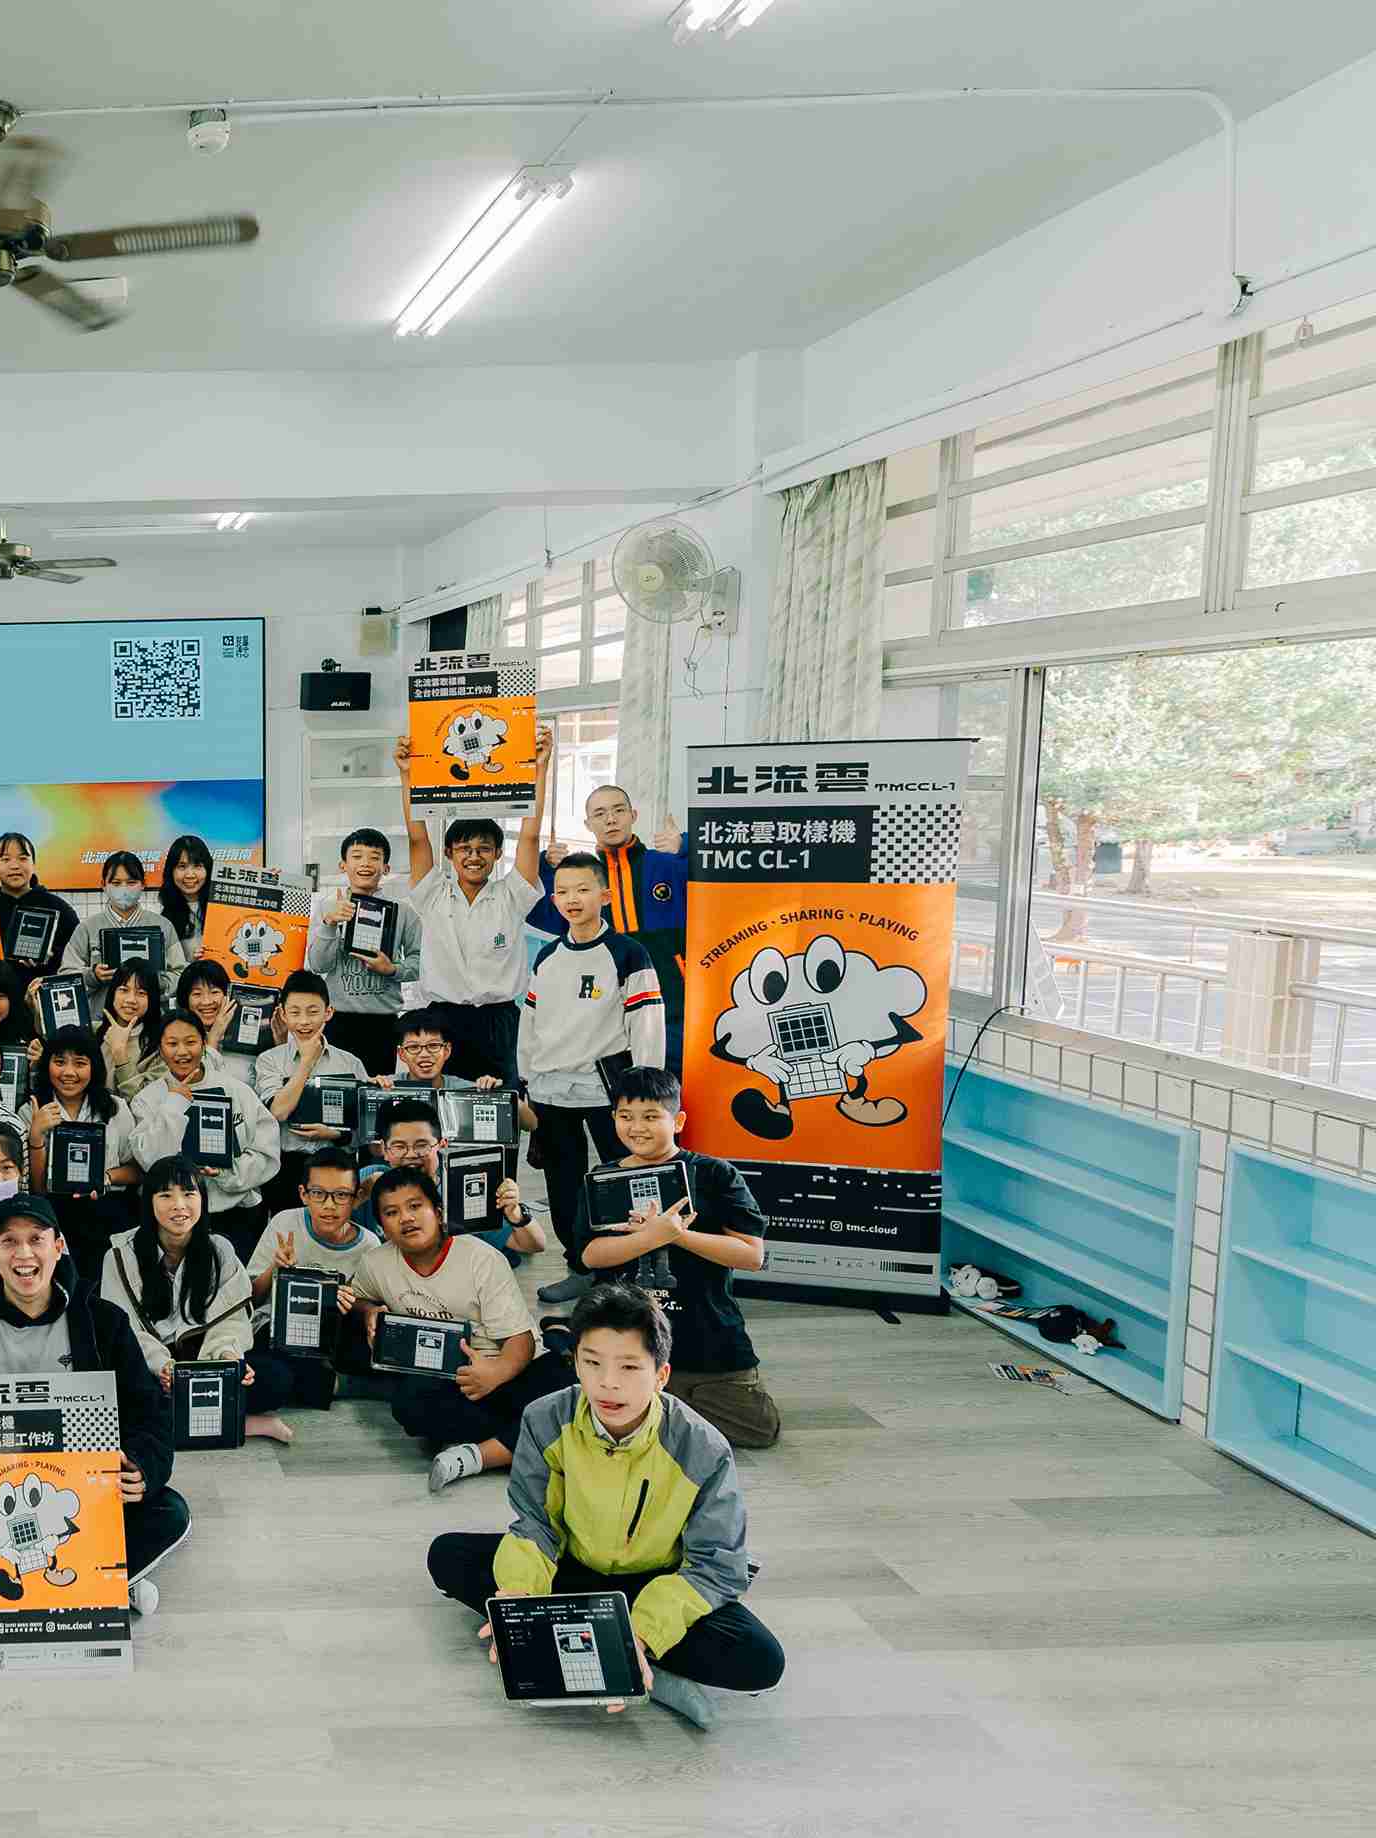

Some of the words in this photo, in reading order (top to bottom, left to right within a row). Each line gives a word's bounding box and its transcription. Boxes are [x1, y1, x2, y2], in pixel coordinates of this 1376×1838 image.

[697, 762, 869, 794] 北流雲
[874, 782, 955, 793] TMCCL-1
[698, 819, 857, 845] 北流雲取樣機
[697, 850, 752, 869] TMC
[758, 849, 811, 869] CL-1
[700, 920, 769, 969] STREAMING
[780, 909, 845, 925] SHARING
[858, 912, 920, 941] PLAYING
[846, 1222, 898, 1235] tmc.cloud
